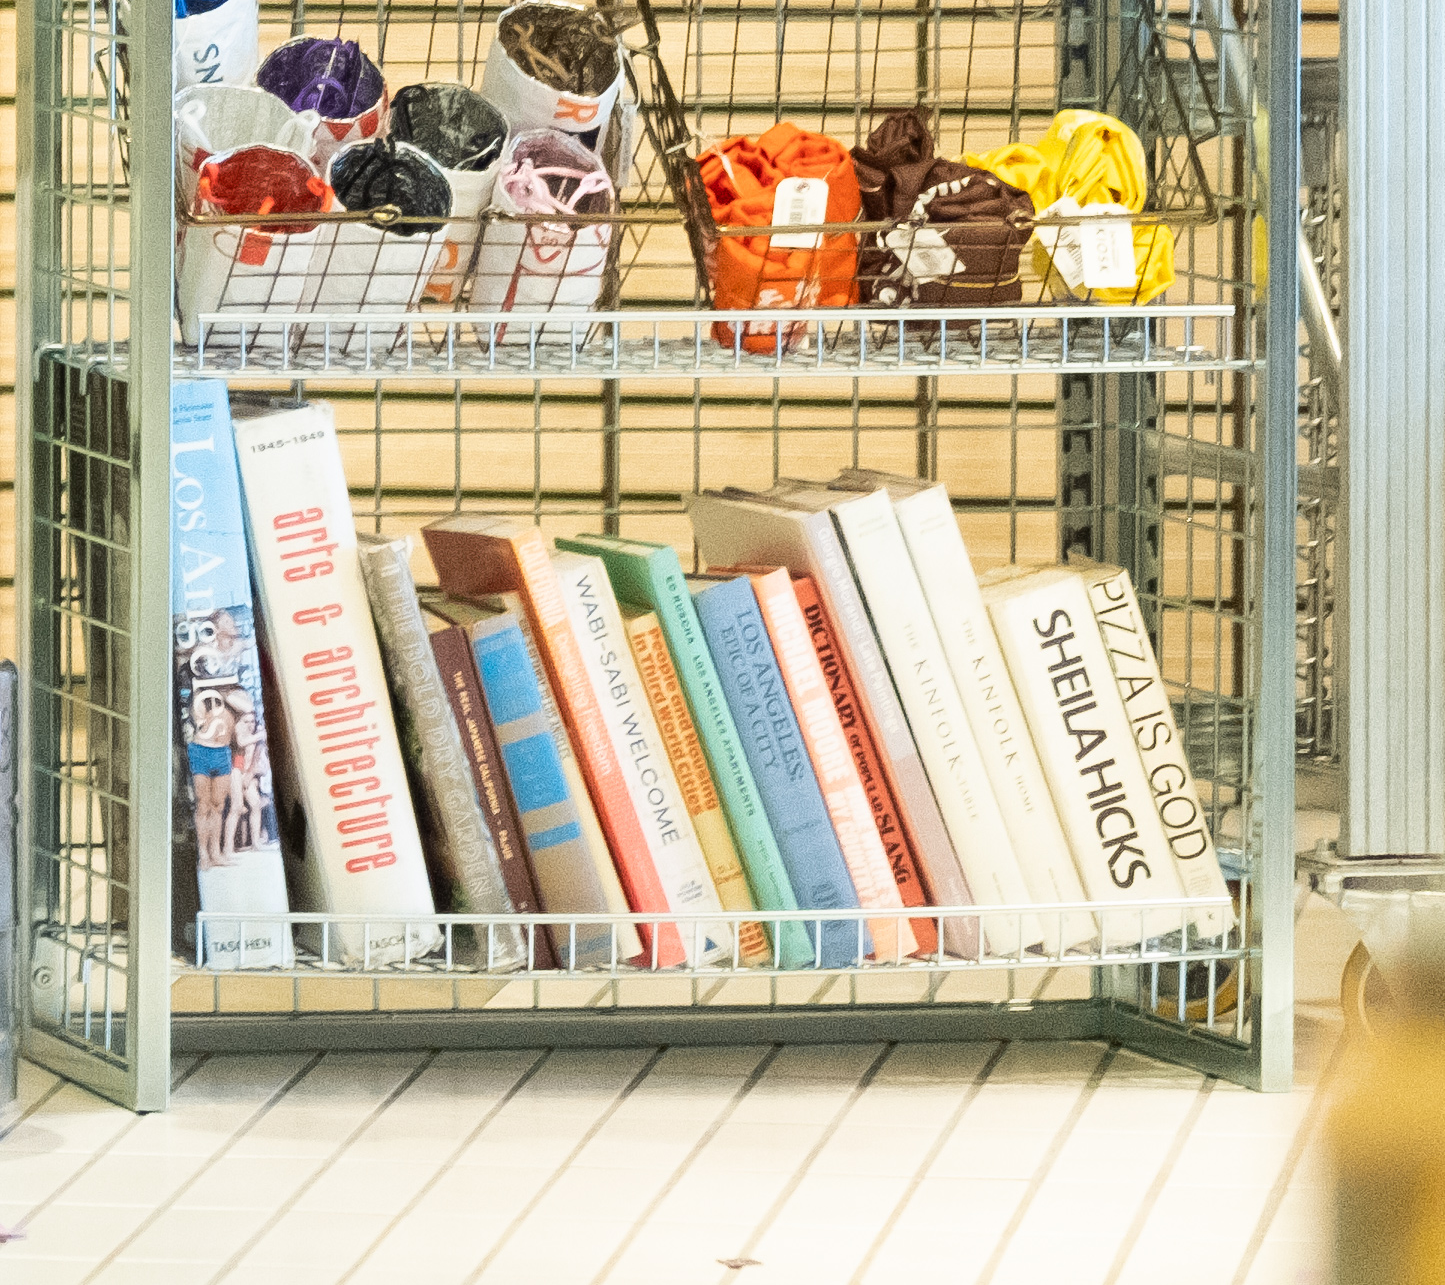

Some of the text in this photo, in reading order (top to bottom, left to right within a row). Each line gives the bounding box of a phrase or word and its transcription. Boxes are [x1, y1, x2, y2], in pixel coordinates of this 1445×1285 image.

[172, 437, 216, 532] Los
[273, 506, 340, 583] arts
[175, 541, 240, 741] Angeles
[520, 542, 566, 629] CALIFORNIA
[301, 644, 398, 876] architecture
[453, 670, 464, 688] THE
[466, 717, 485, 762] JAPANESE
[479, 763, 501, 816] CALIFORNIA
[575, 574, 680, 845] WABI-SABI WELCOME
[692, 653, 707, 680] LOS
[702, 681, 726, 732] ANGELES
[720, 736, 756, 819] APARTMENTS
[720, 624, 780, 774] EPIC OF A CITY
[734, 608, 807, 784] LOS ANGELES:
[767, 591, 851, 785] MICHAEL MOORE
[802, 602, 856, 730] DICTIONARY
[875, 813, 911, 886] SLANG
[904, 624, 963, 773] THE KINFOLK
[963, 620, 1035, 815] THE KINFOLK HOME
[1032, 608, 1153, 891] SHEILA HICKS
[1091, 581, 1208, 861] PIZZA IS GOD
[442, 791, 493, 901] GARDEN
